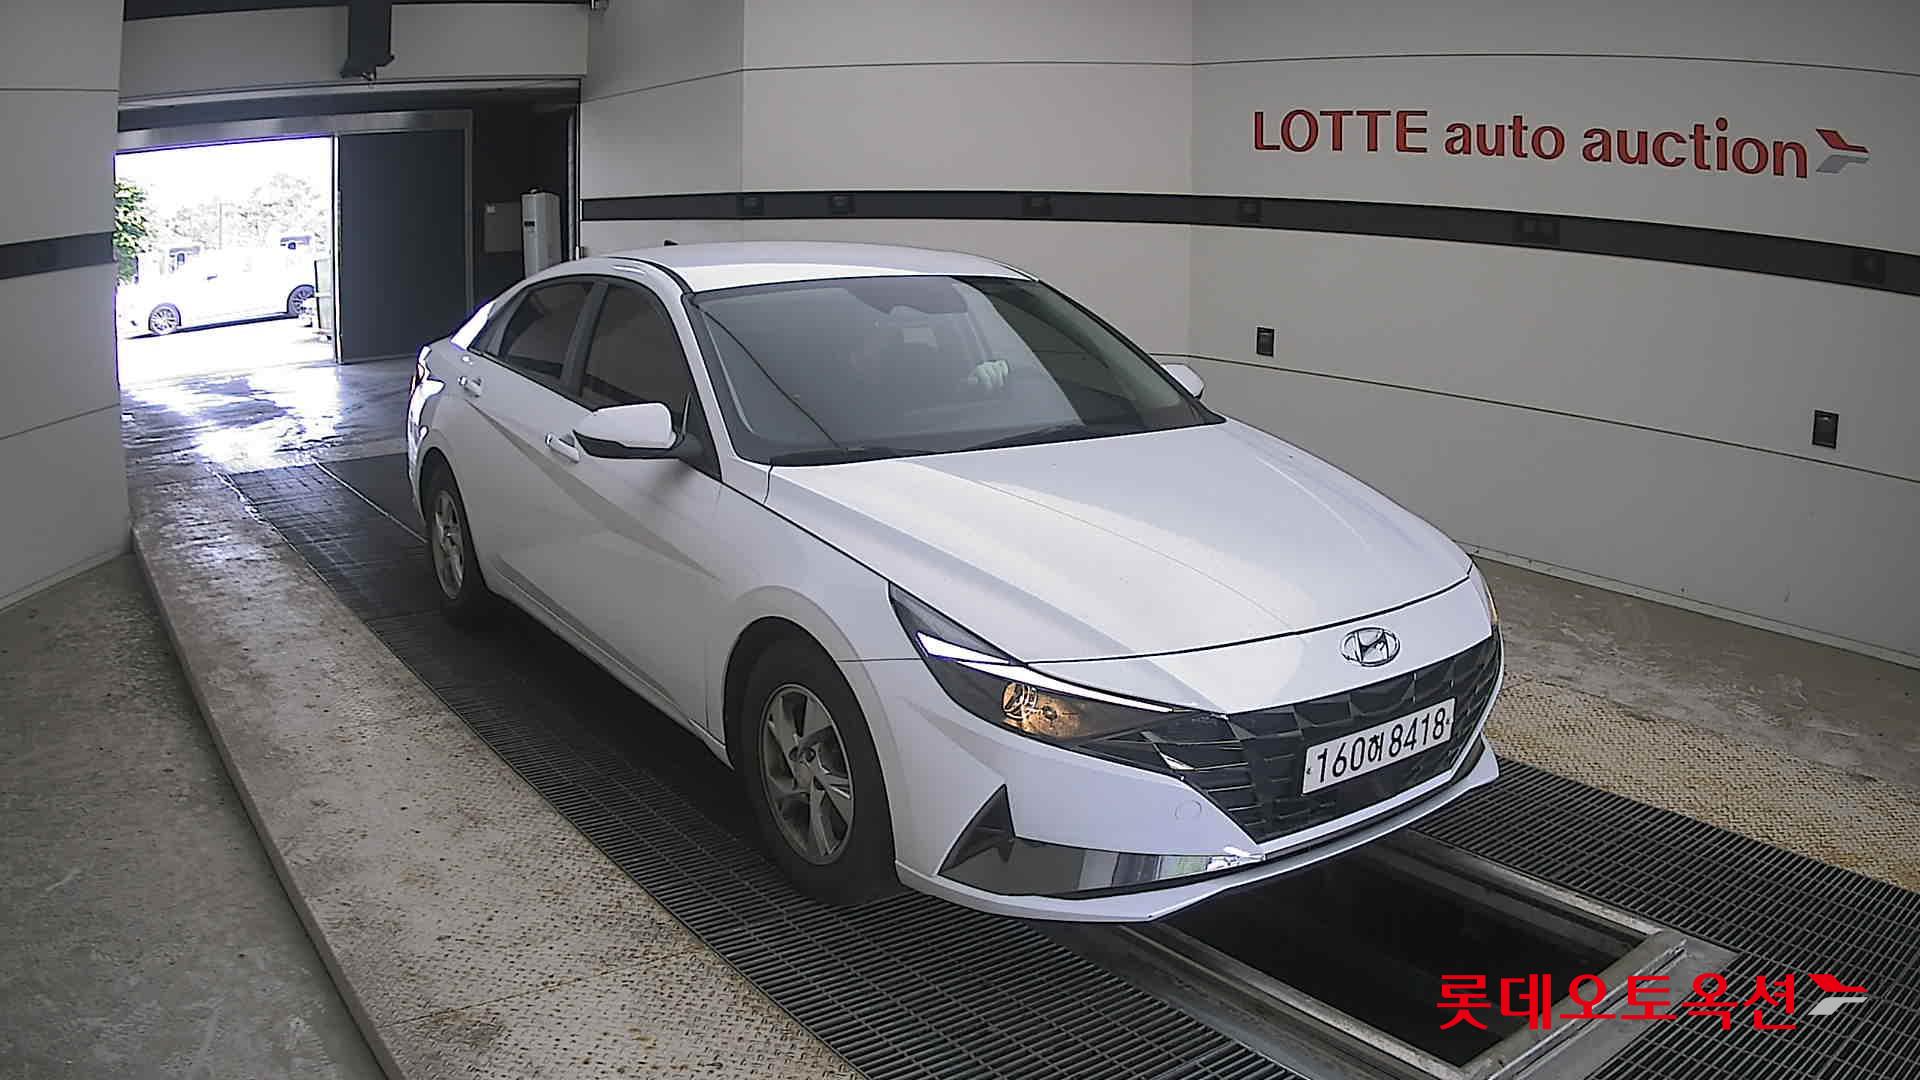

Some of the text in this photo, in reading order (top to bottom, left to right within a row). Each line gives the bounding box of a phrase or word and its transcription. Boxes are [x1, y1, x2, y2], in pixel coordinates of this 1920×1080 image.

[1253, 110, 1809, 179] LOTTE auto auction
